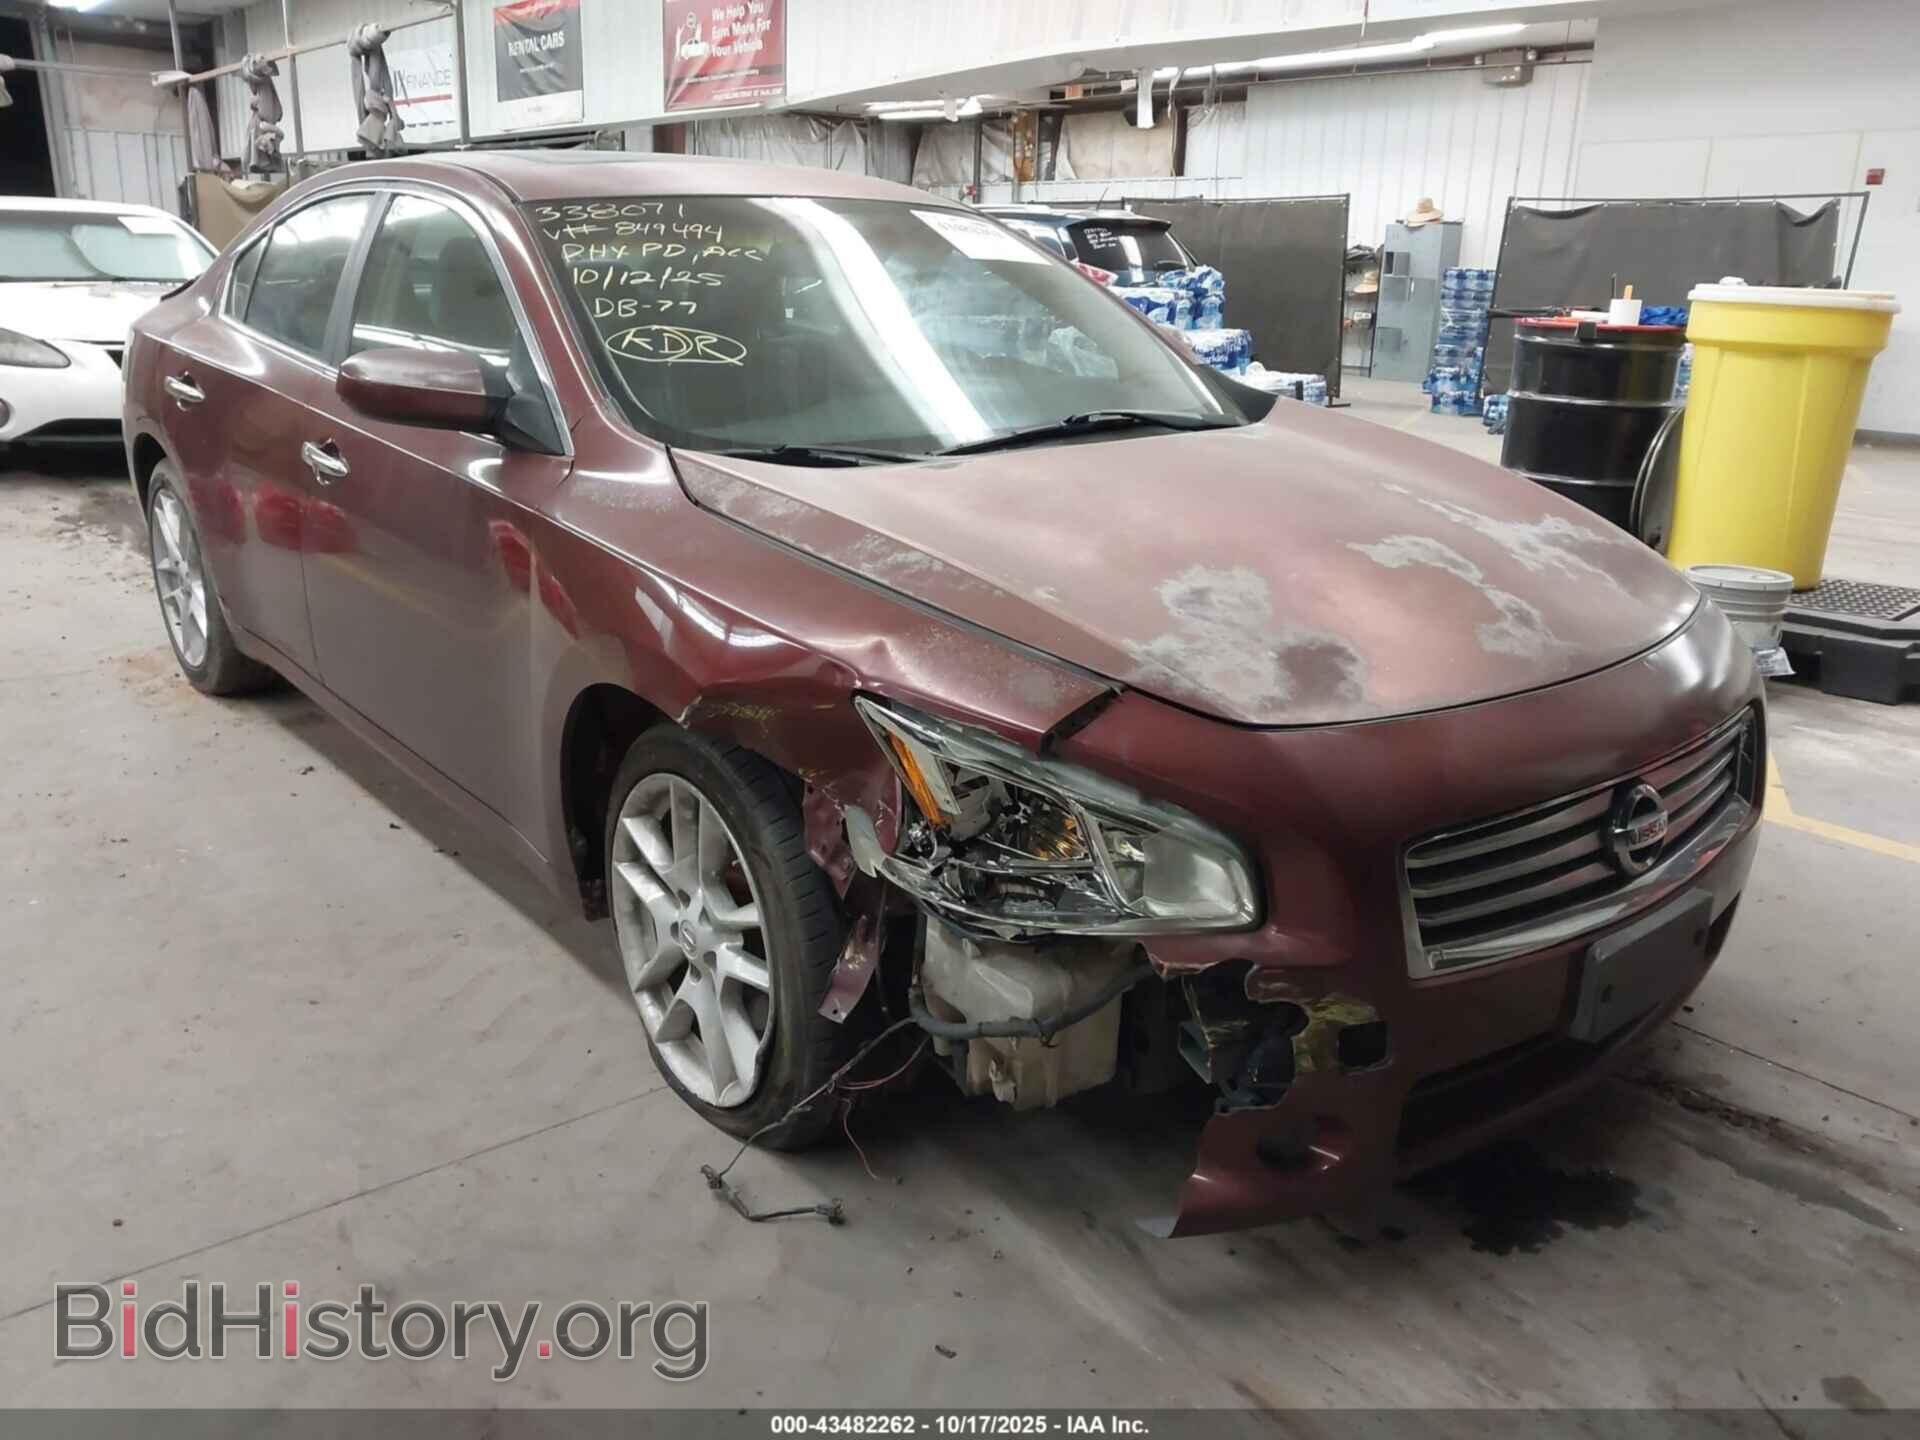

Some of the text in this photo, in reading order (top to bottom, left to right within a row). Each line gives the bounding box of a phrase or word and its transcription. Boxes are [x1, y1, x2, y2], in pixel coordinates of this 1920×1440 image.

[711, 0, 764, 21] We Help You
[731, 20, 755, 36] More
[756, 17, 772, 32] For
[507, 30, 565, 57] RENTAL CARS
[535, 203, 684, 222] 338071
[614, 221, 723, 243] 849494
[573, 265, 727, 290] 10/12/25
